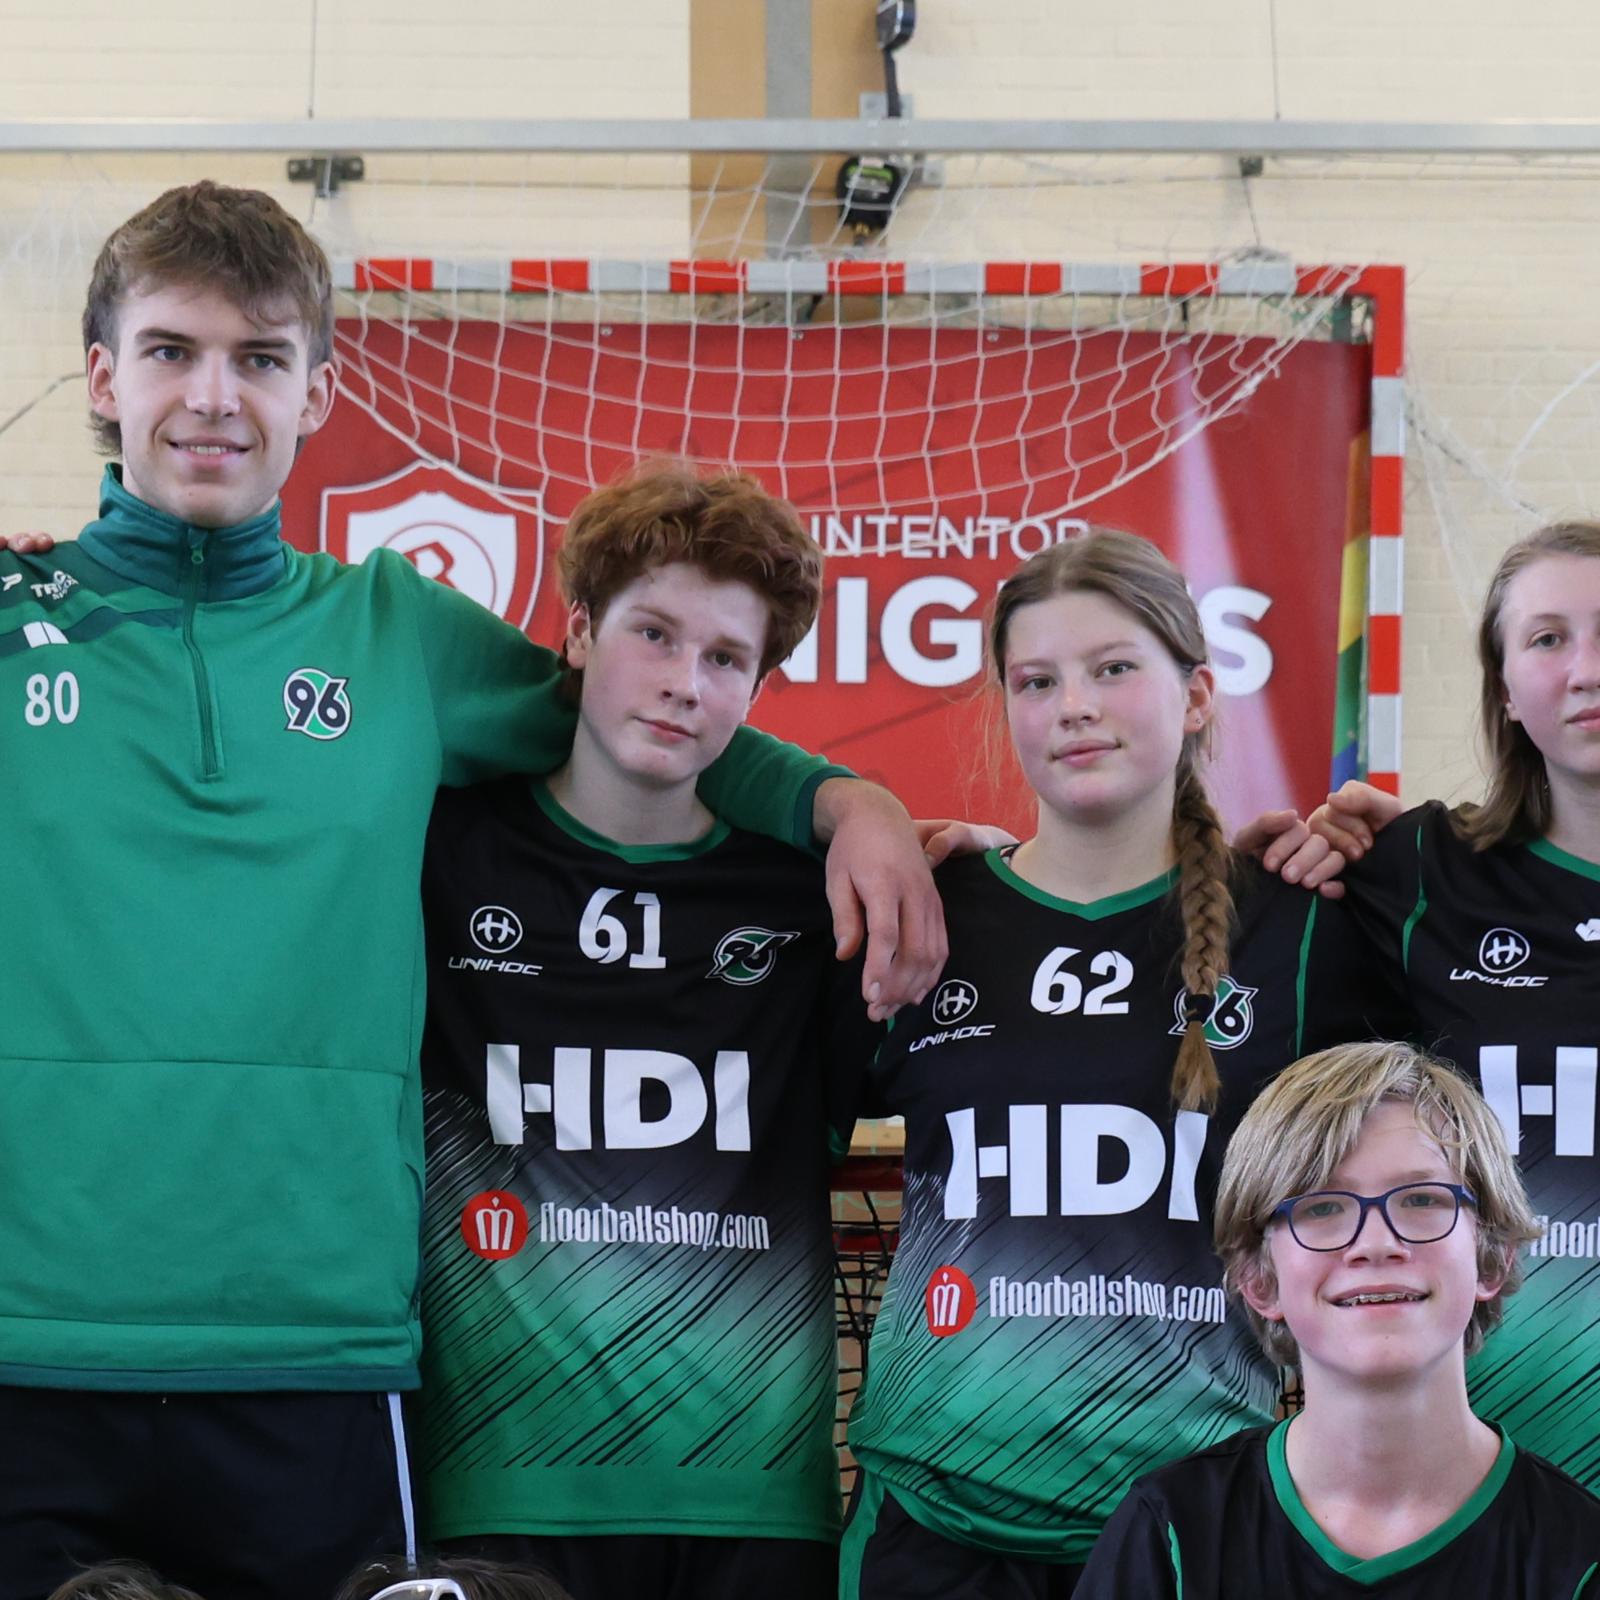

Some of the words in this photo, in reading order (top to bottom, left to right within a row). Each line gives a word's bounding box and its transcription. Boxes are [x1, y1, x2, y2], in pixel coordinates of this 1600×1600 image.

[25, 671, 80, 726] 80
[284, 673, 349, 734] 96
[578, 887, 666, 969] 61
[448, 956, 543, 976] UNIHOC
[1031, 946, 1134, 1016] 62
[909, 1024, 996, 1053] UNIHOC
[487, 1043, 751, 1152] HDI
[944, 1104, 1209, 1222] HDI
[540, 1202, 770, 1251] floorballshop.com
[989, 1274, 1226, 1324] floorballshop.com
